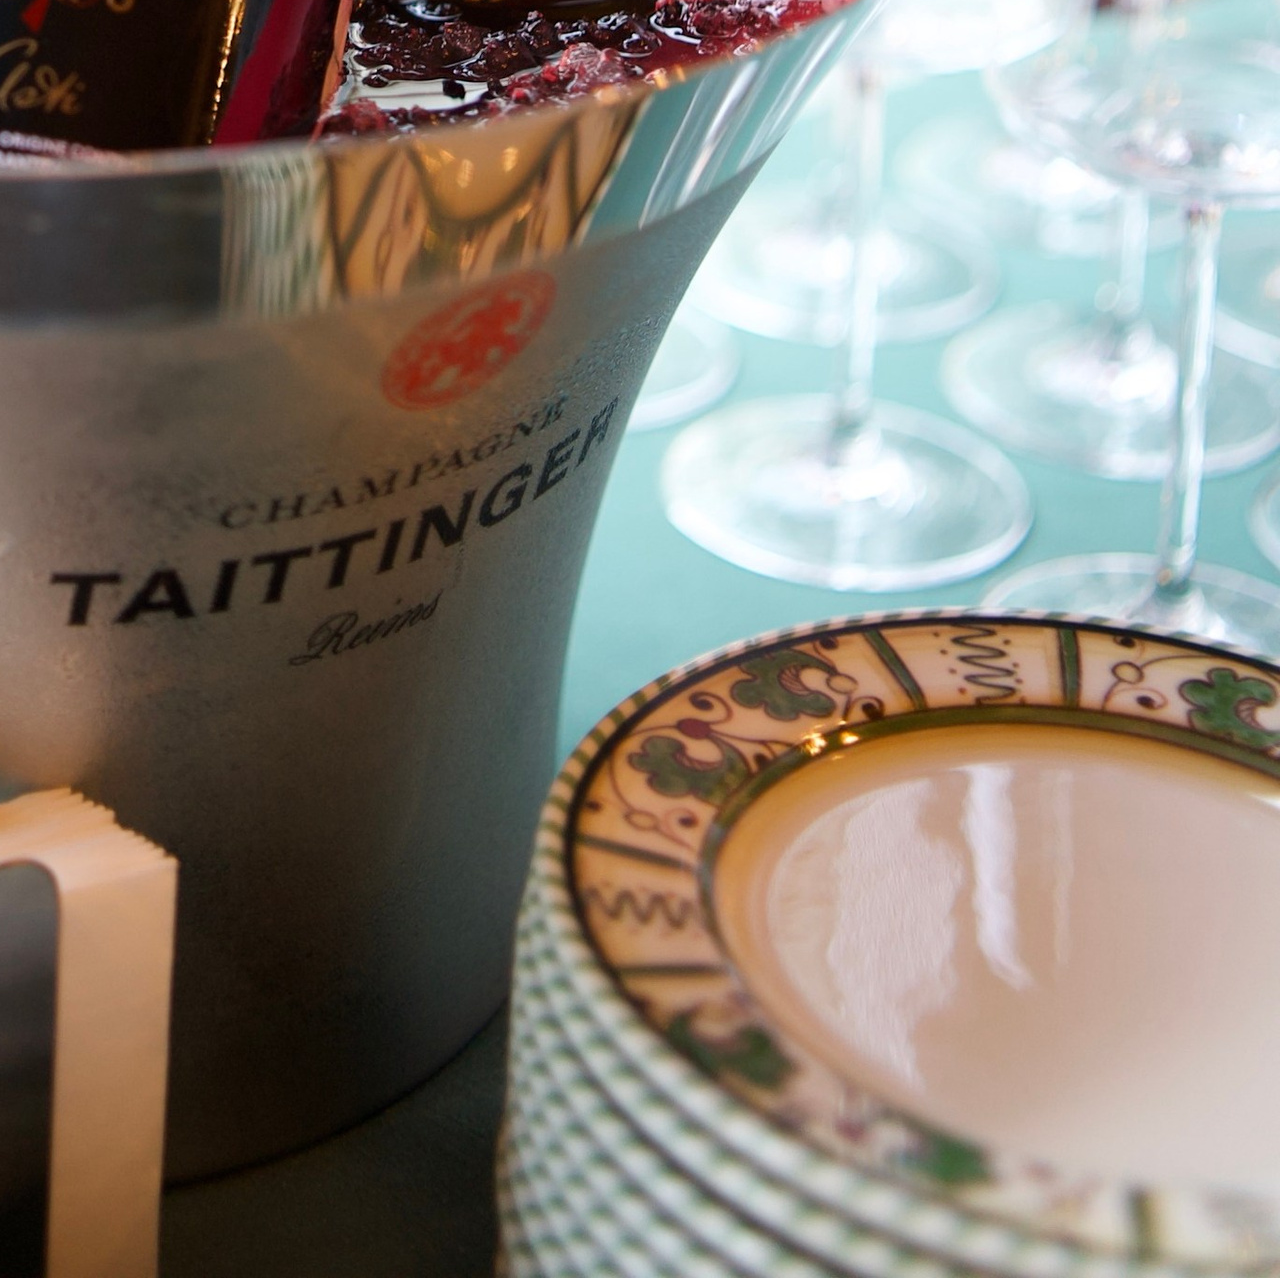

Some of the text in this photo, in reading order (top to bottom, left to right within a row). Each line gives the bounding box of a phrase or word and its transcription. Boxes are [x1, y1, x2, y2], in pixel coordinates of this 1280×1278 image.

[50, 396, 619, 627] TAITTINGER
[221, 396, 568, 530] CHAMPAGNE
[289, 589, 444, 666] Reims
